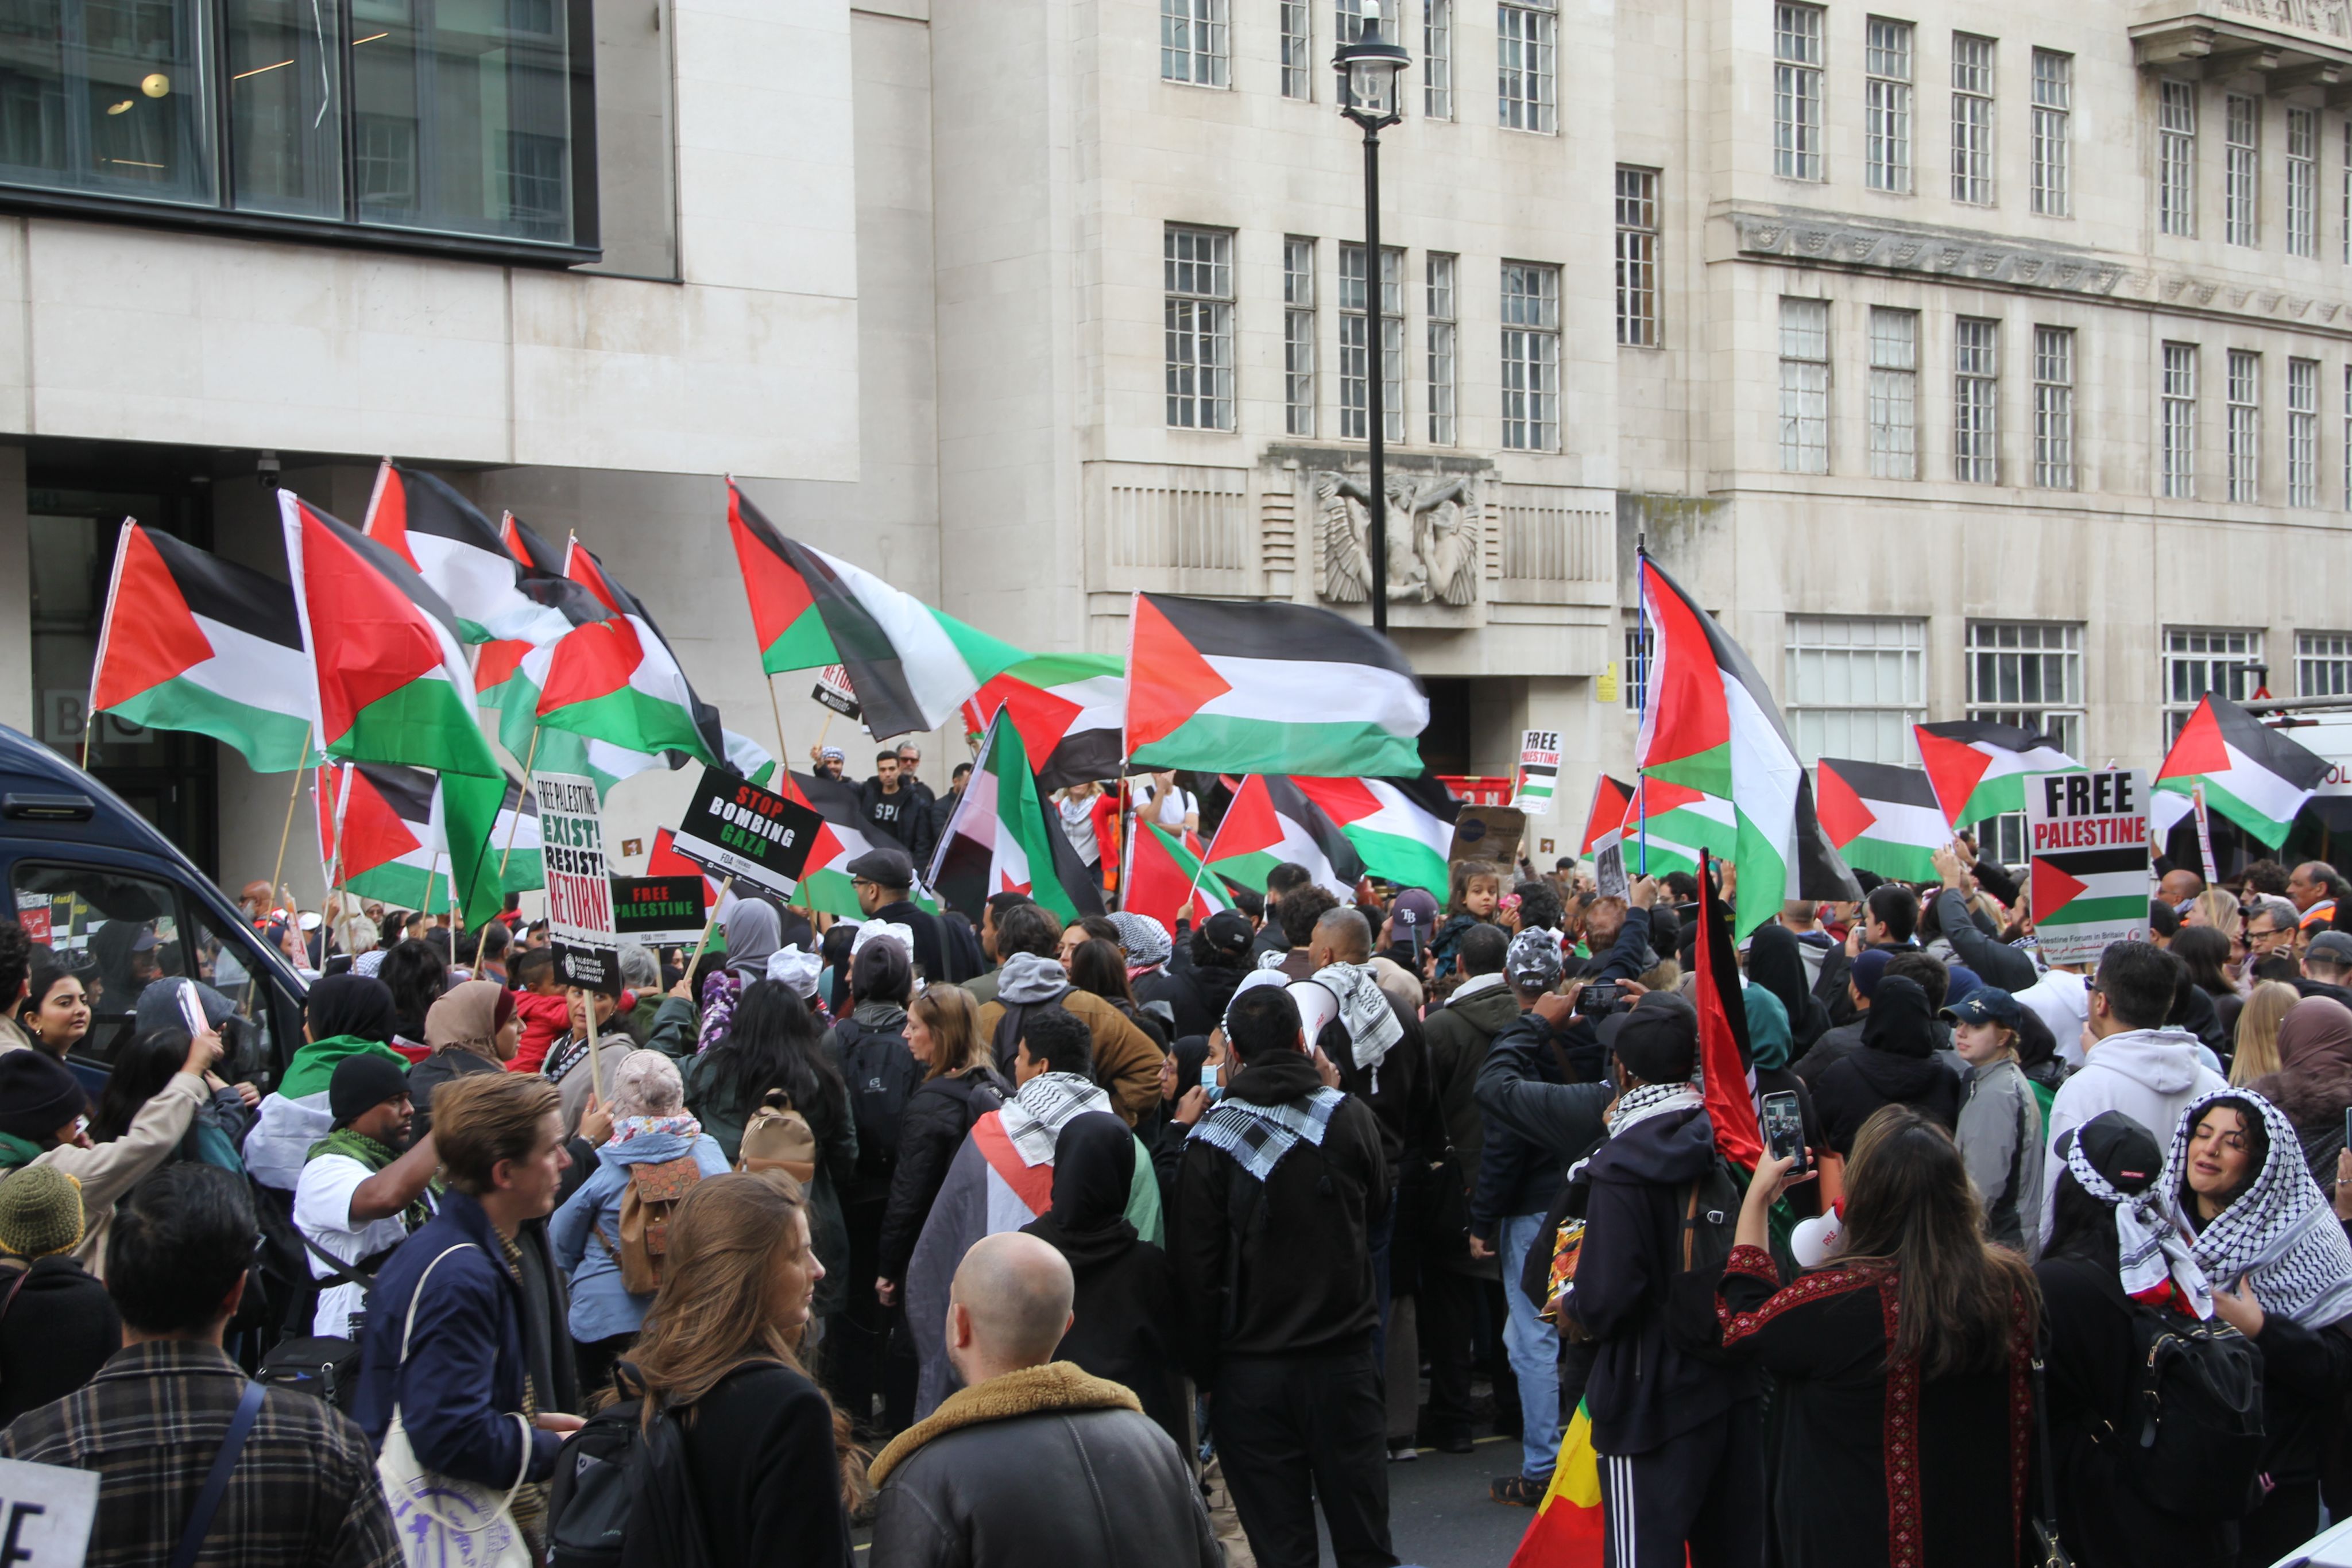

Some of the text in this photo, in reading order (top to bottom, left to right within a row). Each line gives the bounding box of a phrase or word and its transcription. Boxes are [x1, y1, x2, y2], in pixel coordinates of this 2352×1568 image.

[1526, 731, 1558, 750] FREE
[1522, 751, 1560, 765] PALESTINE
[537, 780, 597, 815] FREE PALESTINE
[736, 785, 785, 818] STOP
[2044, 772, 2134, 818] FREE
[541, 813, 602, 849] EXIST!
[709, 796, 795, 848] BOMBING
[2034, 816, 2146, 850] PALESTINE
[719, 824, 768, 858] GAZA
[545, 845, 605, 877] RESIST!
[548, 870, 610, 933] RETURN!
[614, 901, 694, 919] PALESTINE
[632, 886, 670, 902] FREE
[1401, 908, 1416, 923] TB
[2040, 936, 2067, 944] alestine
[2069, 934, 2092, 942] Forum
[2102, 931, 2125, 939] Britain
[1822, 1230, 1838, 1246] PYLE
